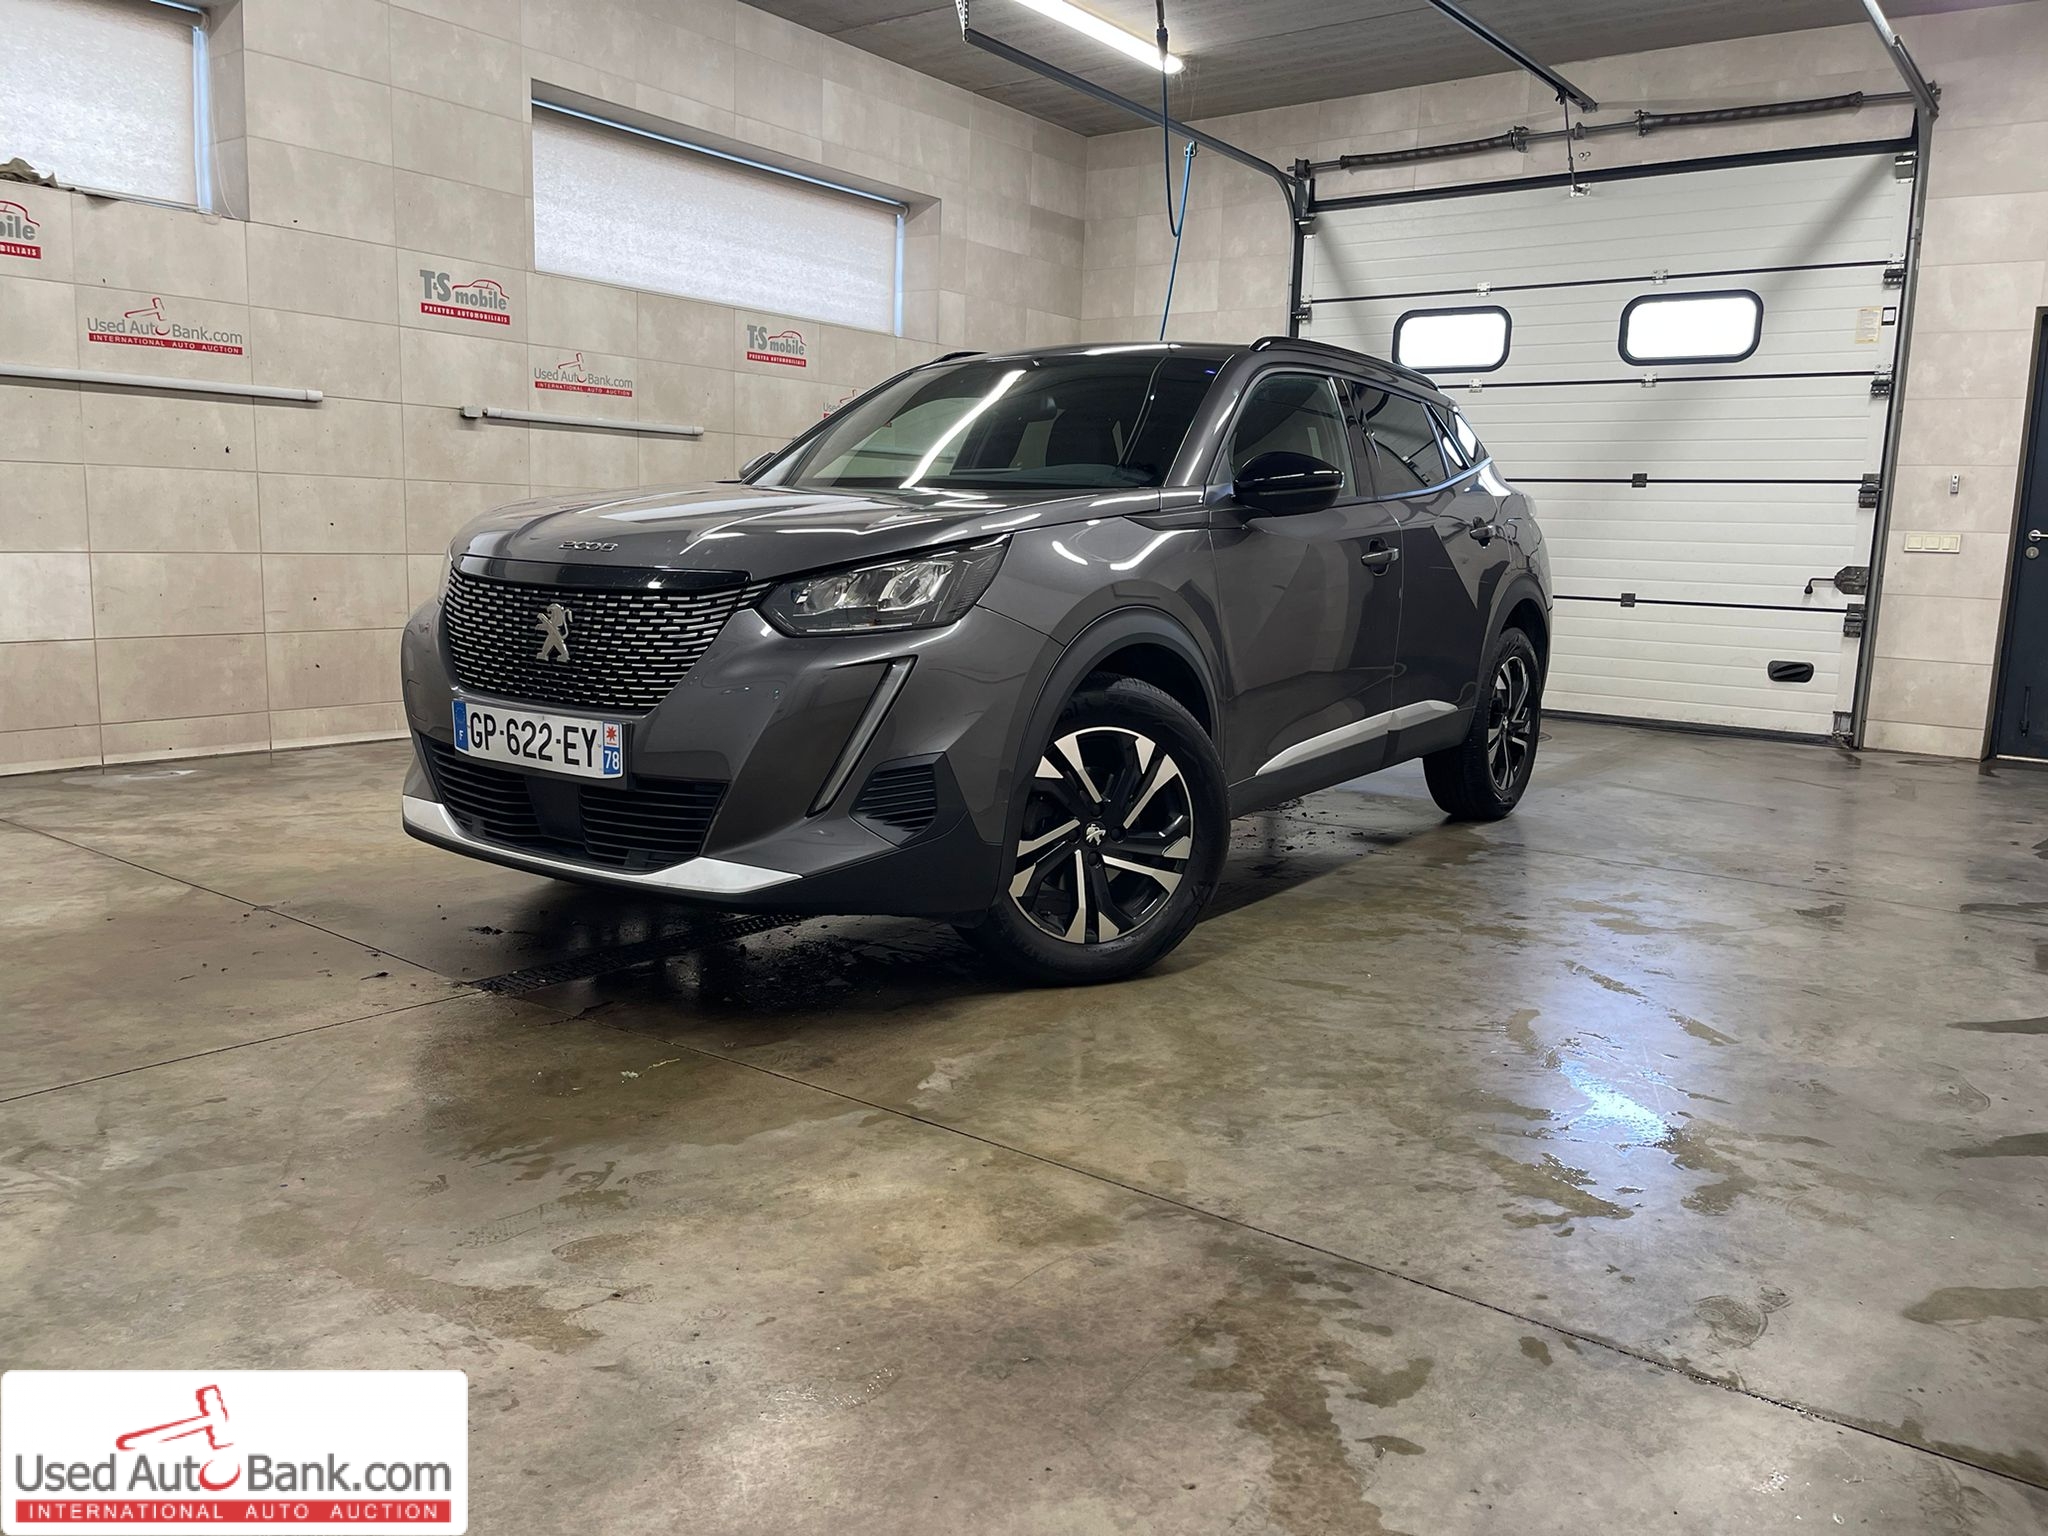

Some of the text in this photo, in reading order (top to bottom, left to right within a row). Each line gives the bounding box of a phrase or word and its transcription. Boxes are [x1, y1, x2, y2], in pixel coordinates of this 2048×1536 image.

[455, 289, 507, 310] mobile
[87, 317, 126, 333] Used
[93, 334, 239, 354] INTERNATIONAL AUTO AUCTION
[770, 338, 805, 356] mobile
[534, 367, 559, 380] Used
[537, 383, 584, 392] INTERNATIONAL
[606, 389, 631, 397] AUCTION
[470, 711, 598, 768] GP-622-EY
[604, 750, 621, 771] 78
